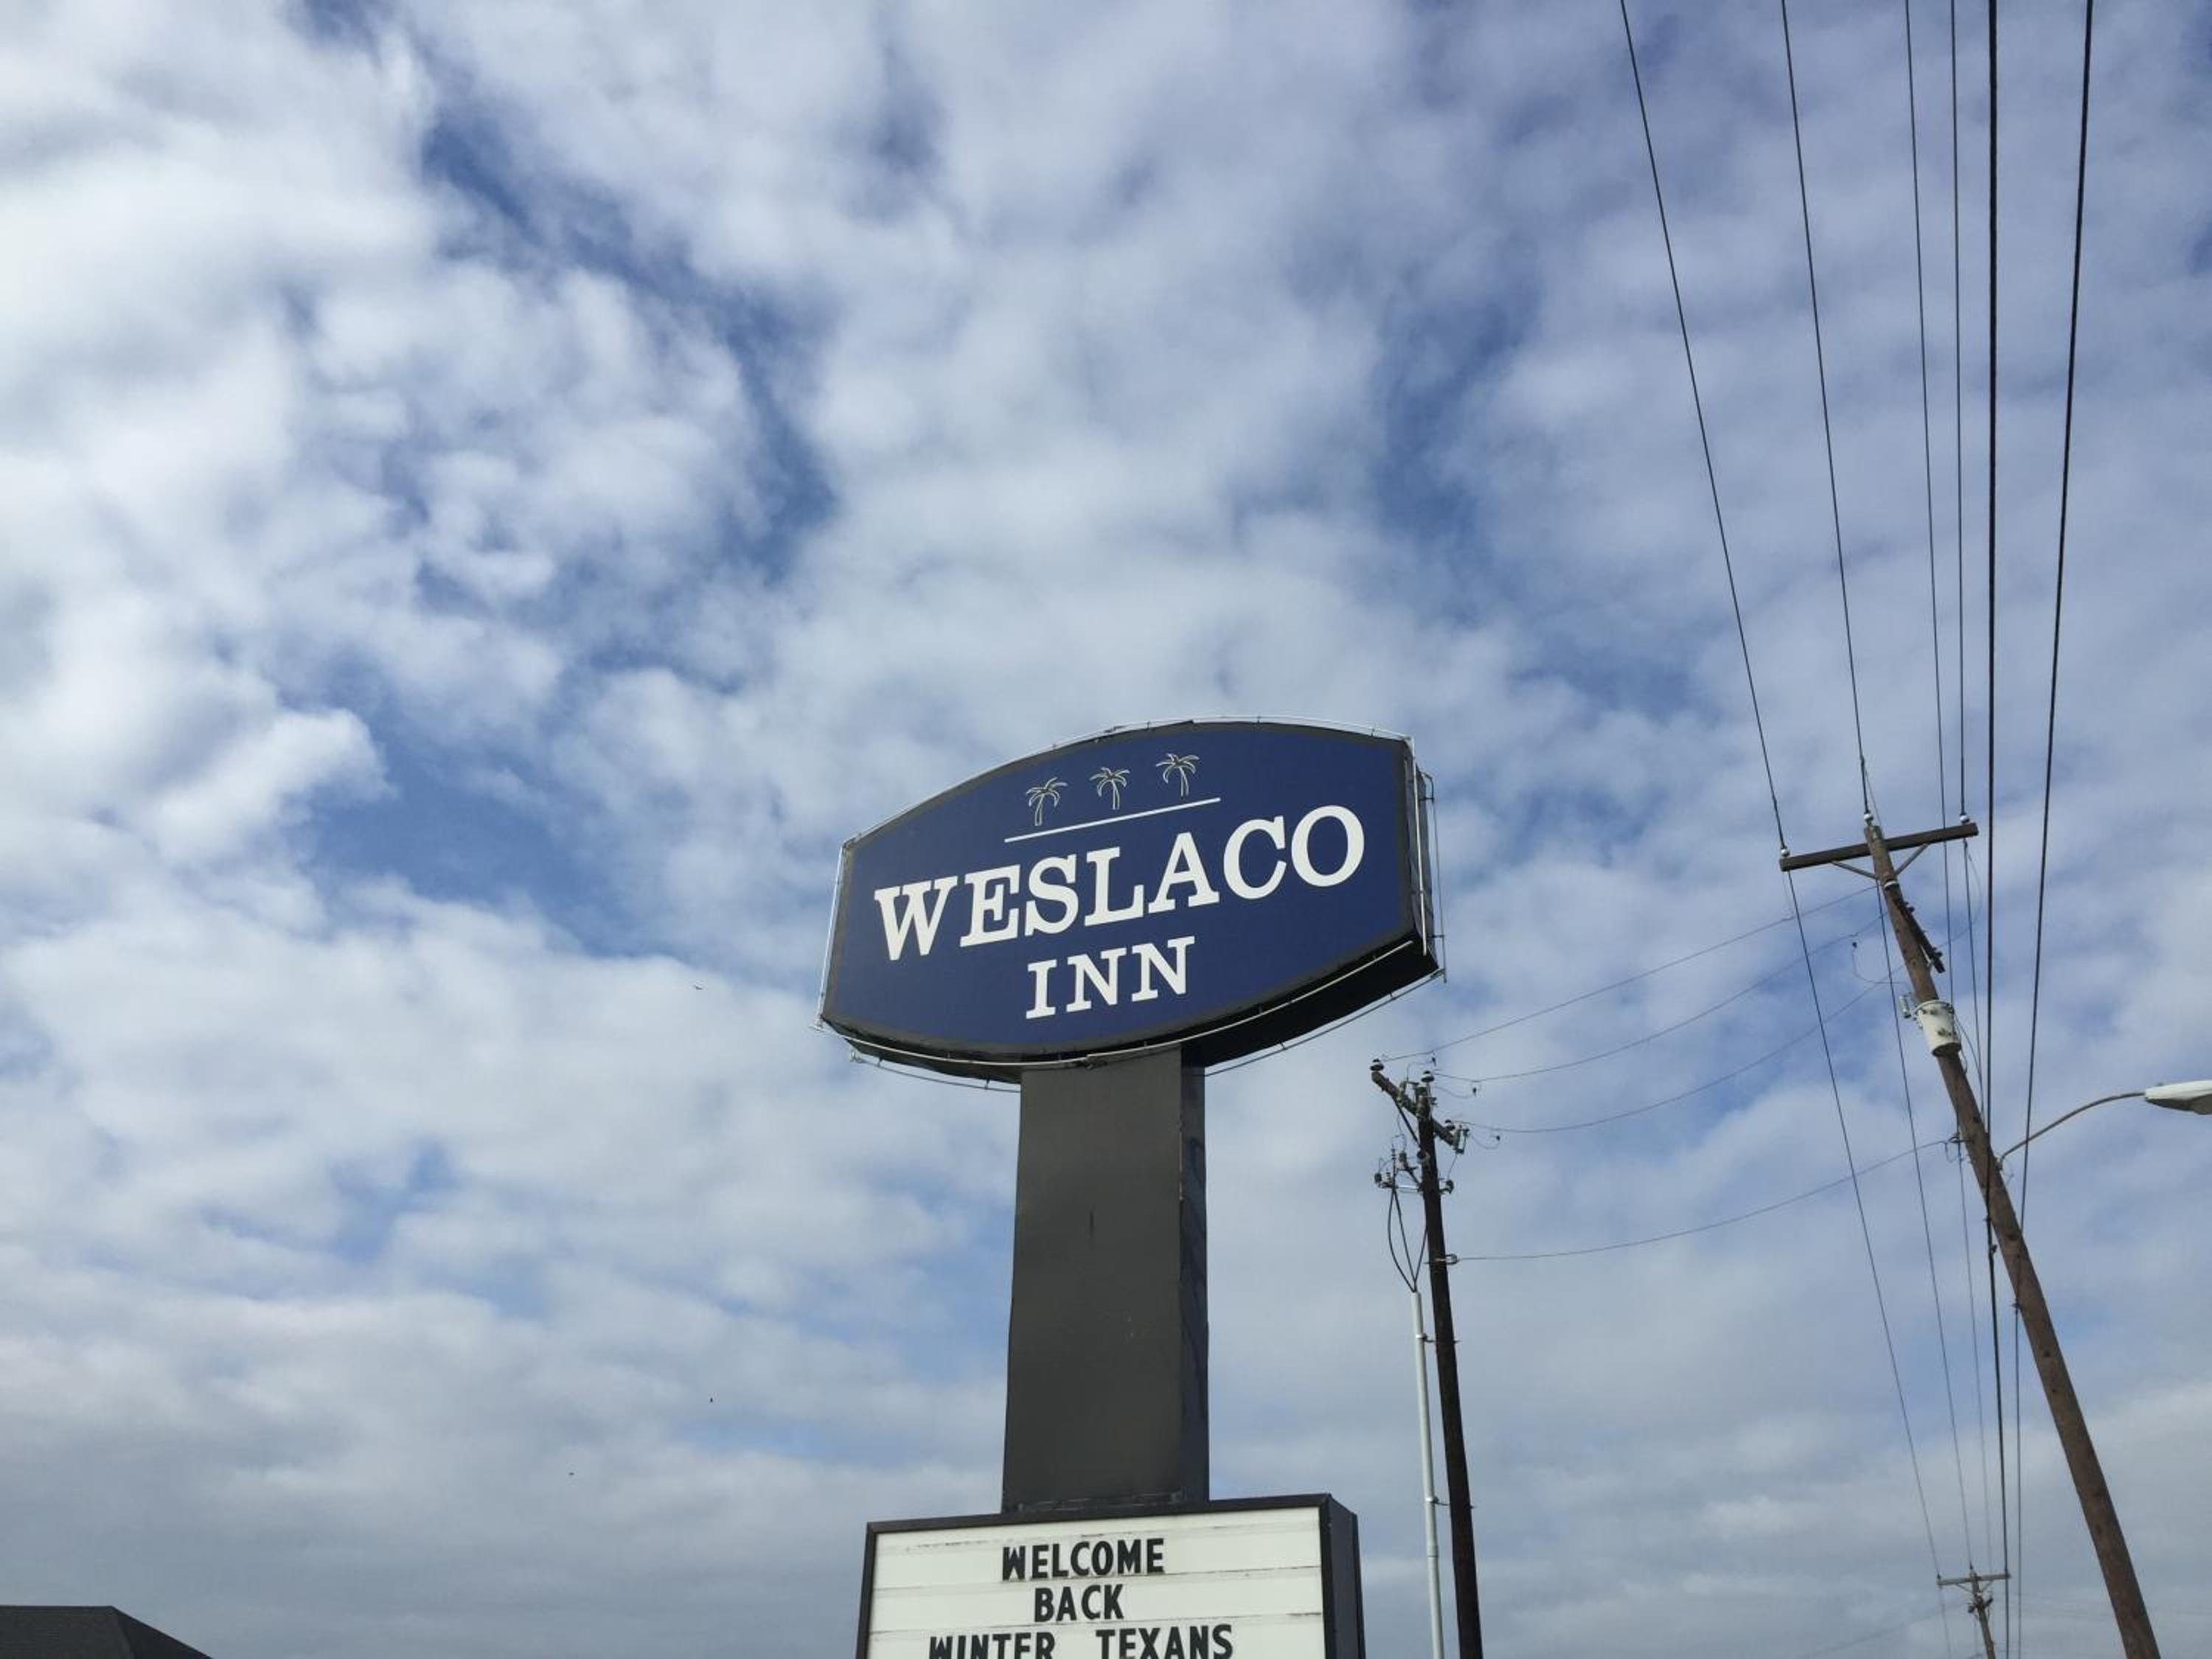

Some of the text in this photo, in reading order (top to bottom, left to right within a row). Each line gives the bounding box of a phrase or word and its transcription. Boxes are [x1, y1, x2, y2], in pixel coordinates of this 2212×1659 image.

[874, 805, 1366, 961] WESLACO
[1026, 936, 1196, 1019] INN
[1003, 1538, 1165, 1581] WELCOME
[1034, 1584, 1124, 1623] BACK
[929, 1624, 1234, 1659] WINTER TEXANS
